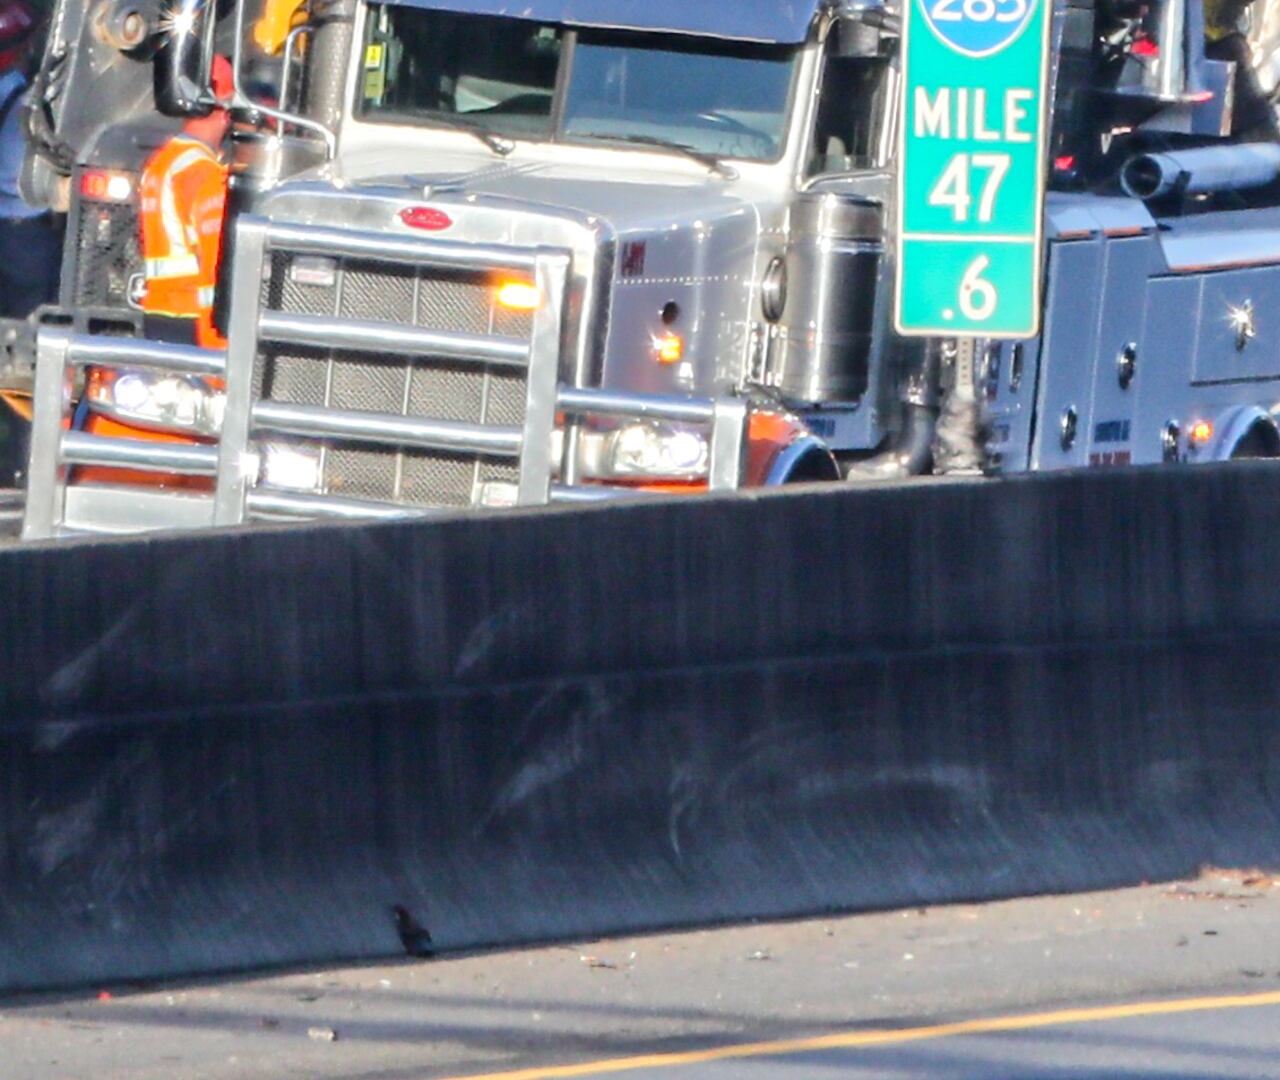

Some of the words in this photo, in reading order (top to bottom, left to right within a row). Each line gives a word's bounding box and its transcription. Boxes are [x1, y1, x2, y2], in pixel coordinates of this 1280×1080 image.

[914, 86, 1034, 143] MILE
[928, 153, 1011, 223] 47
[942, 255, 998, 322] .6
